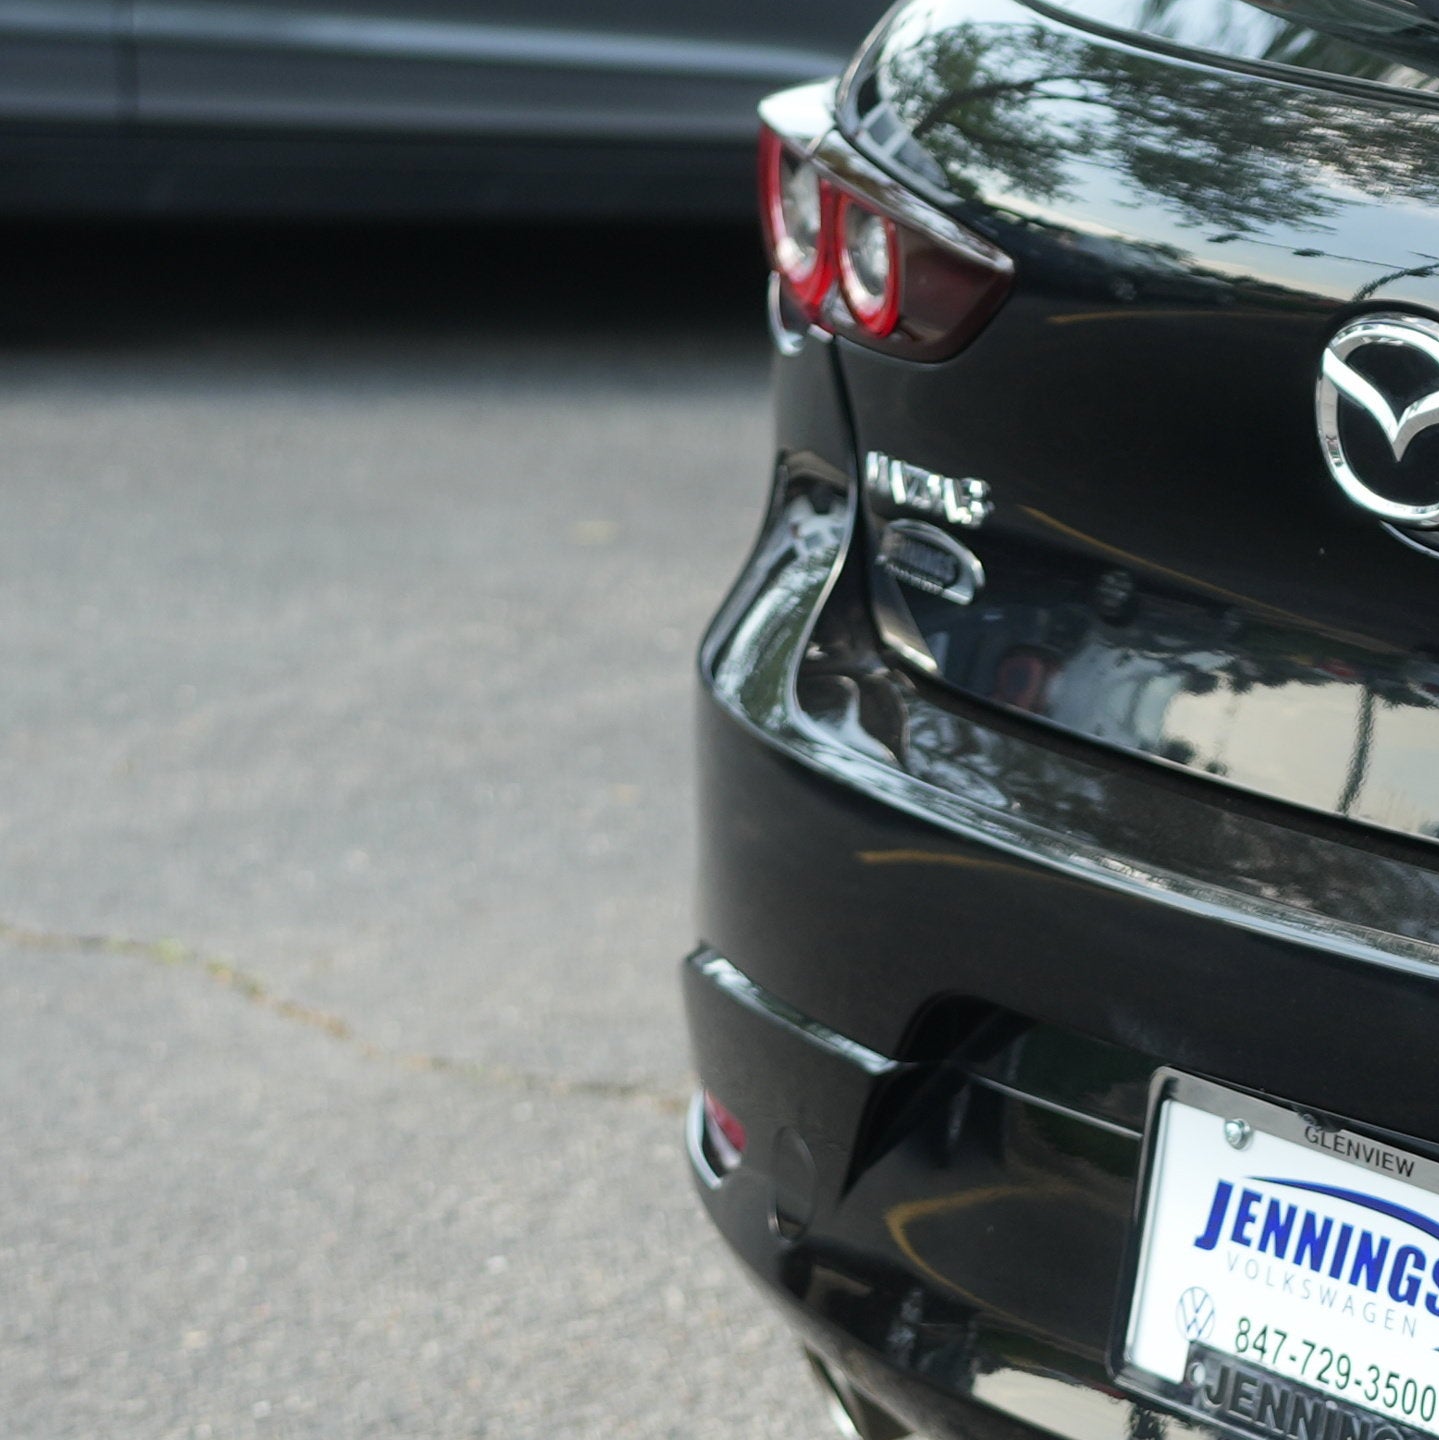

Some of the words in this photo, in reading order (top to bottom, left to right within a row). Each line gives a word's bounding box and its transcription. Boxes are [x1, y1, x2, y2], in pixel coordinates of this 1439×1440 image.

[1303, 1123, 1416, 1178] GLENVIEW
[1225, 1250, 1418, 1339] VOLKSWAGEN
[1234, 1316, 1438, 1423] 847-729-3500
